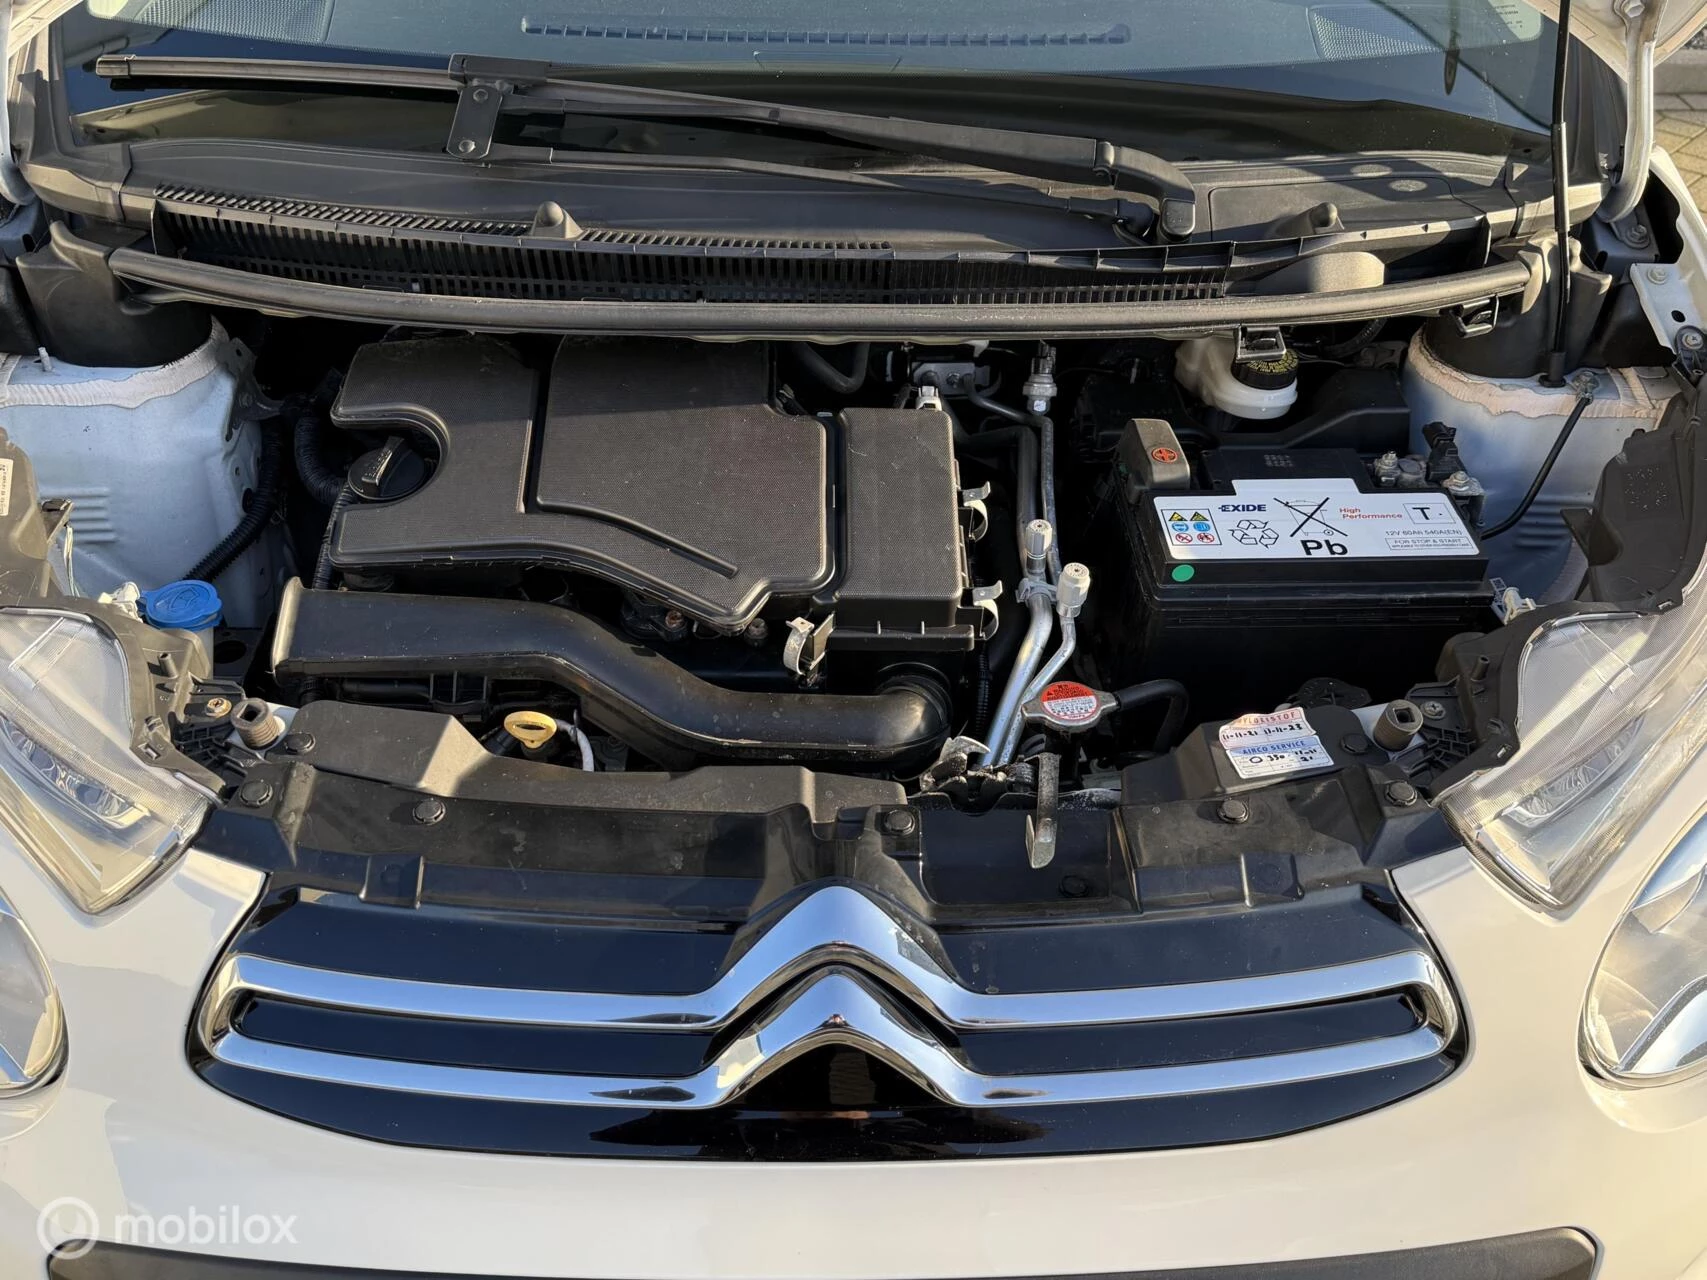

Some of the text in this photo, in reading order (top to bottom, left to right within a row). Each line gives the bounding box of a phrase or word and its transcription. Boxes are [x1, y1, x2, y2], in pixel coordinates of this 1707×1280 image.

[1218, 504, 1267, 513] EXIDE
[1412, 507, 1431, 520] T
[1301, 540, 1348, 556] Pb
[1242, 740, 1305, 755] AIRCO SERVICE
